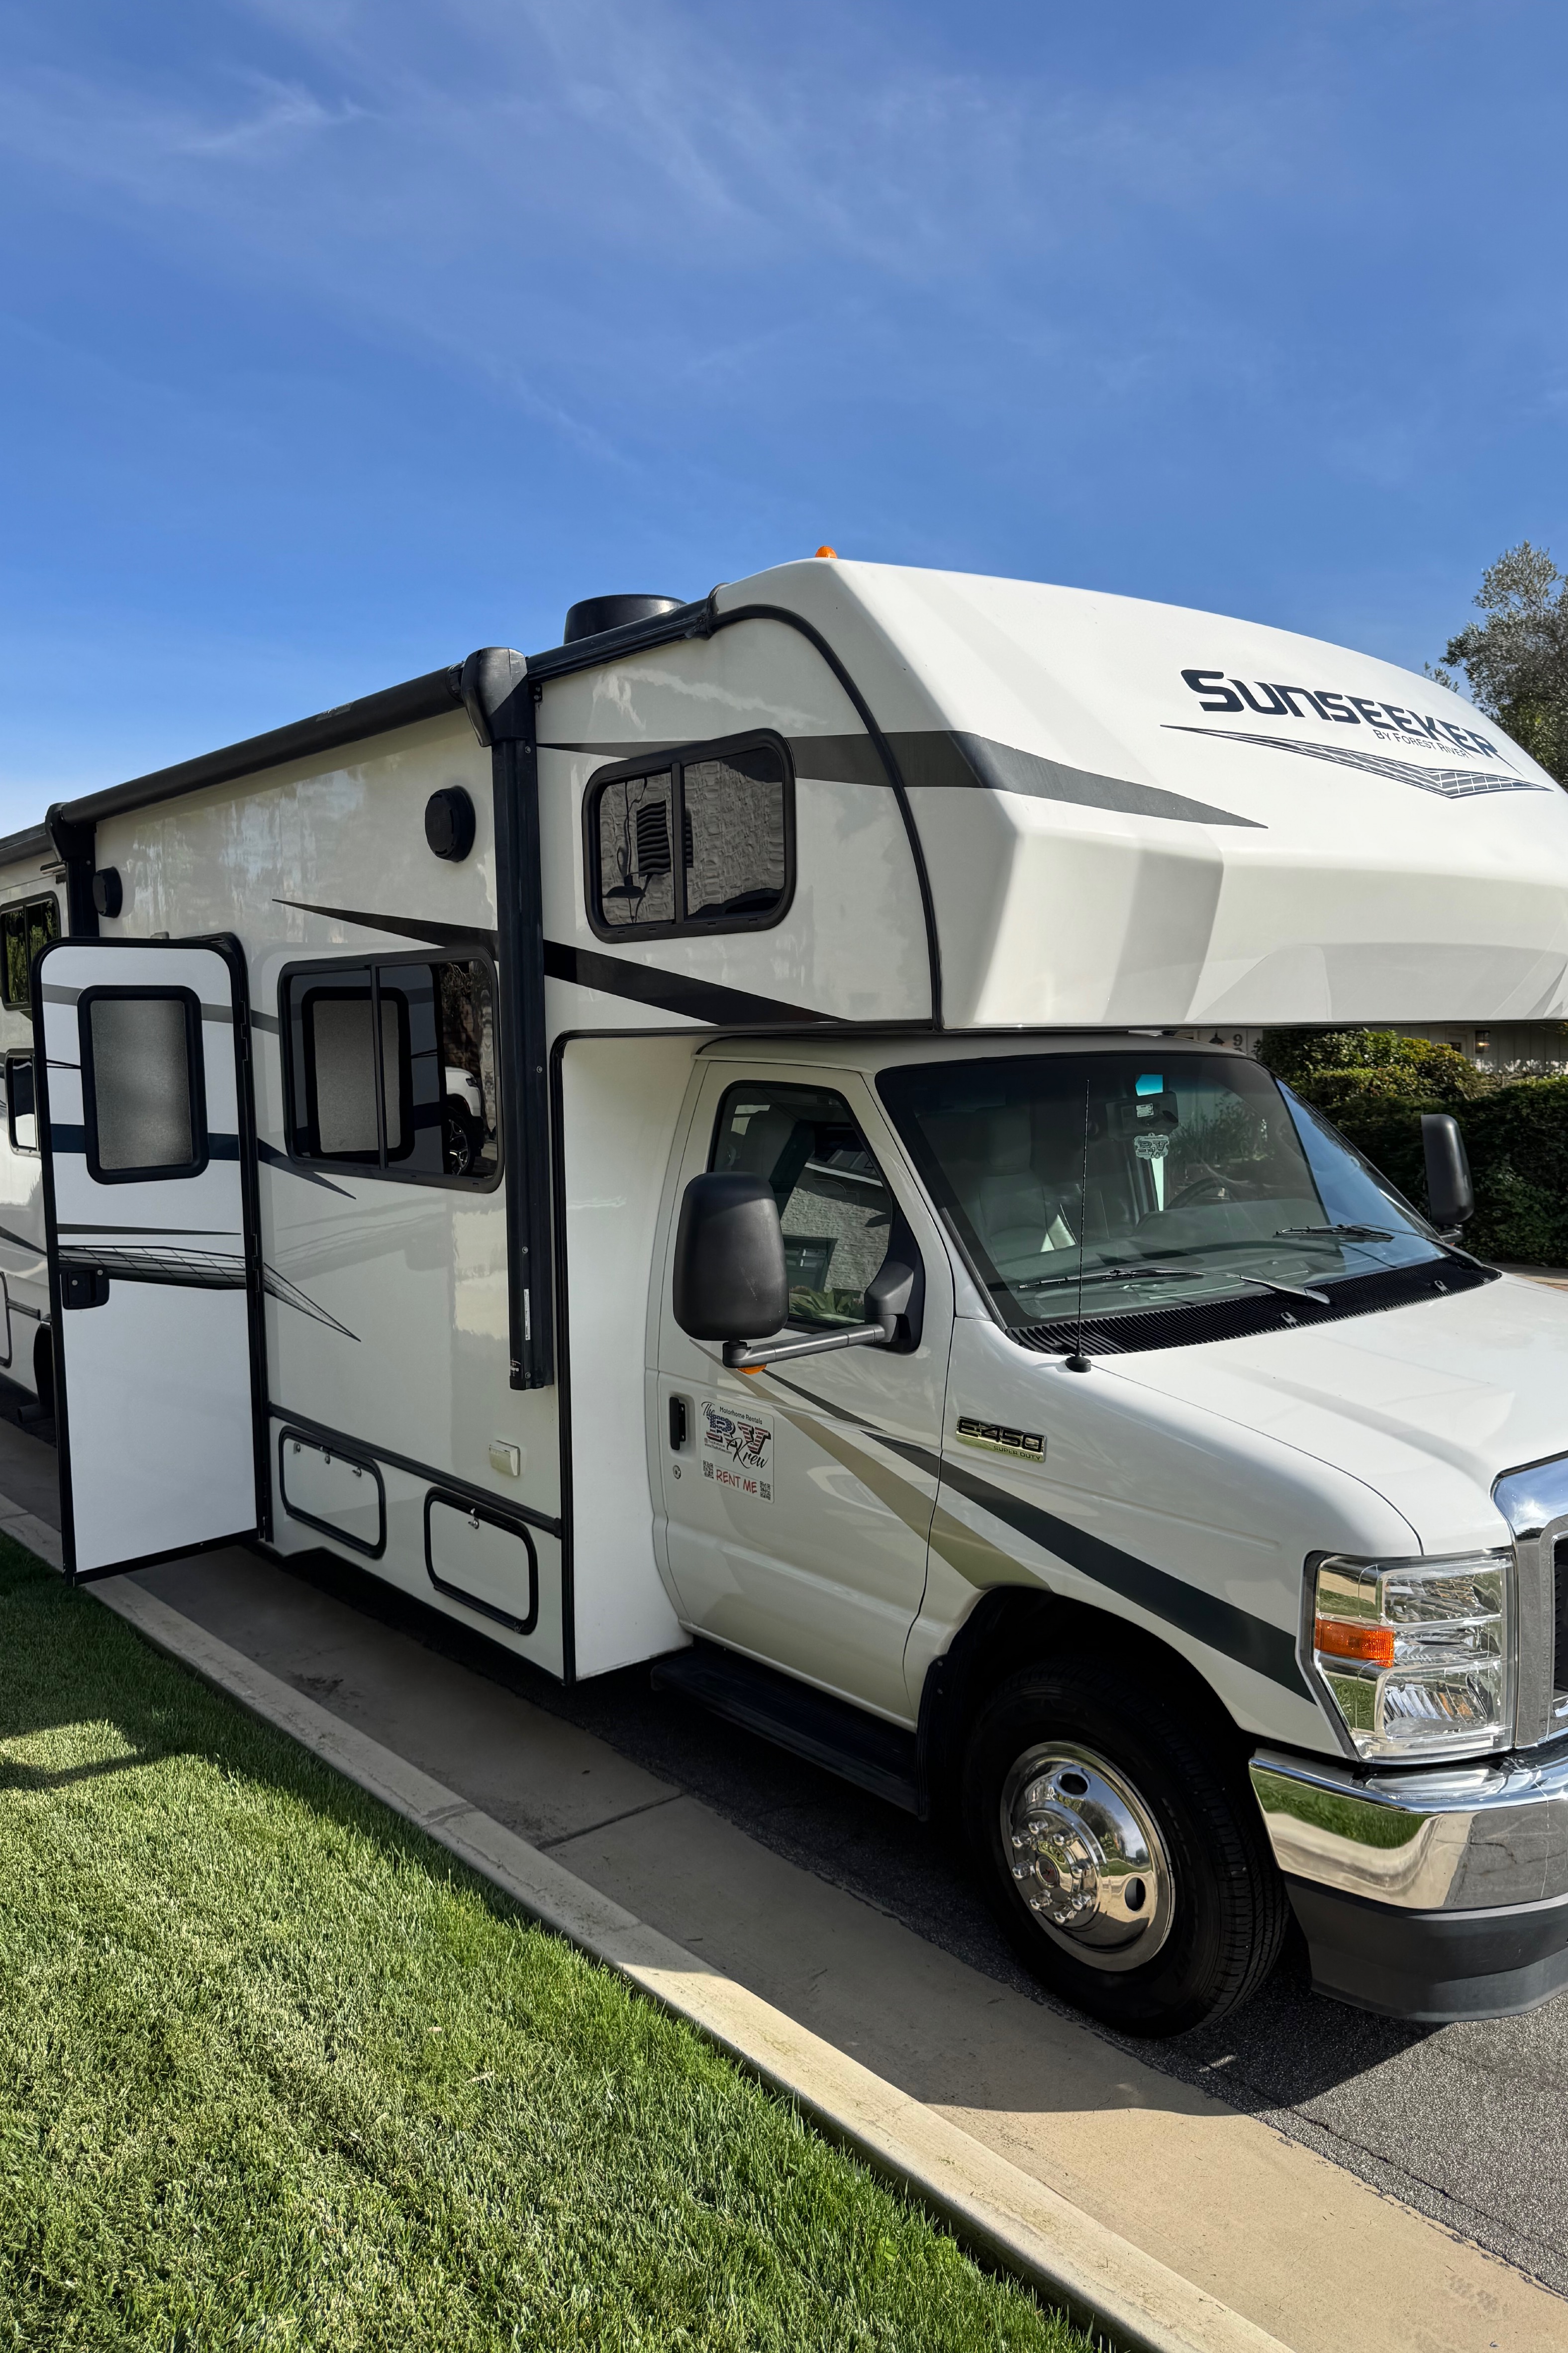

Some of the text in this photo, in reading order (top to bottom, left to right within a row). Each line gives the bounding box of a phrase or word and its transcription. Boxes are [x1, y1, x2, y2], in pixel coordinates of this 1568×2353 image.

[1372, 729, 1470, 759] BY FOREST RIVER
[1233, 1034, 1243, 1051] 9
[719, 1407, 763, 1425] Motorhome Rentals
[706, 1414, 771, 1455] RV
[726, 1437, 770, 1469] Krew
[994, 1445, 1041, 1461] SUPER DUTY
[716, 1469, 757, 1493] RENT ME
